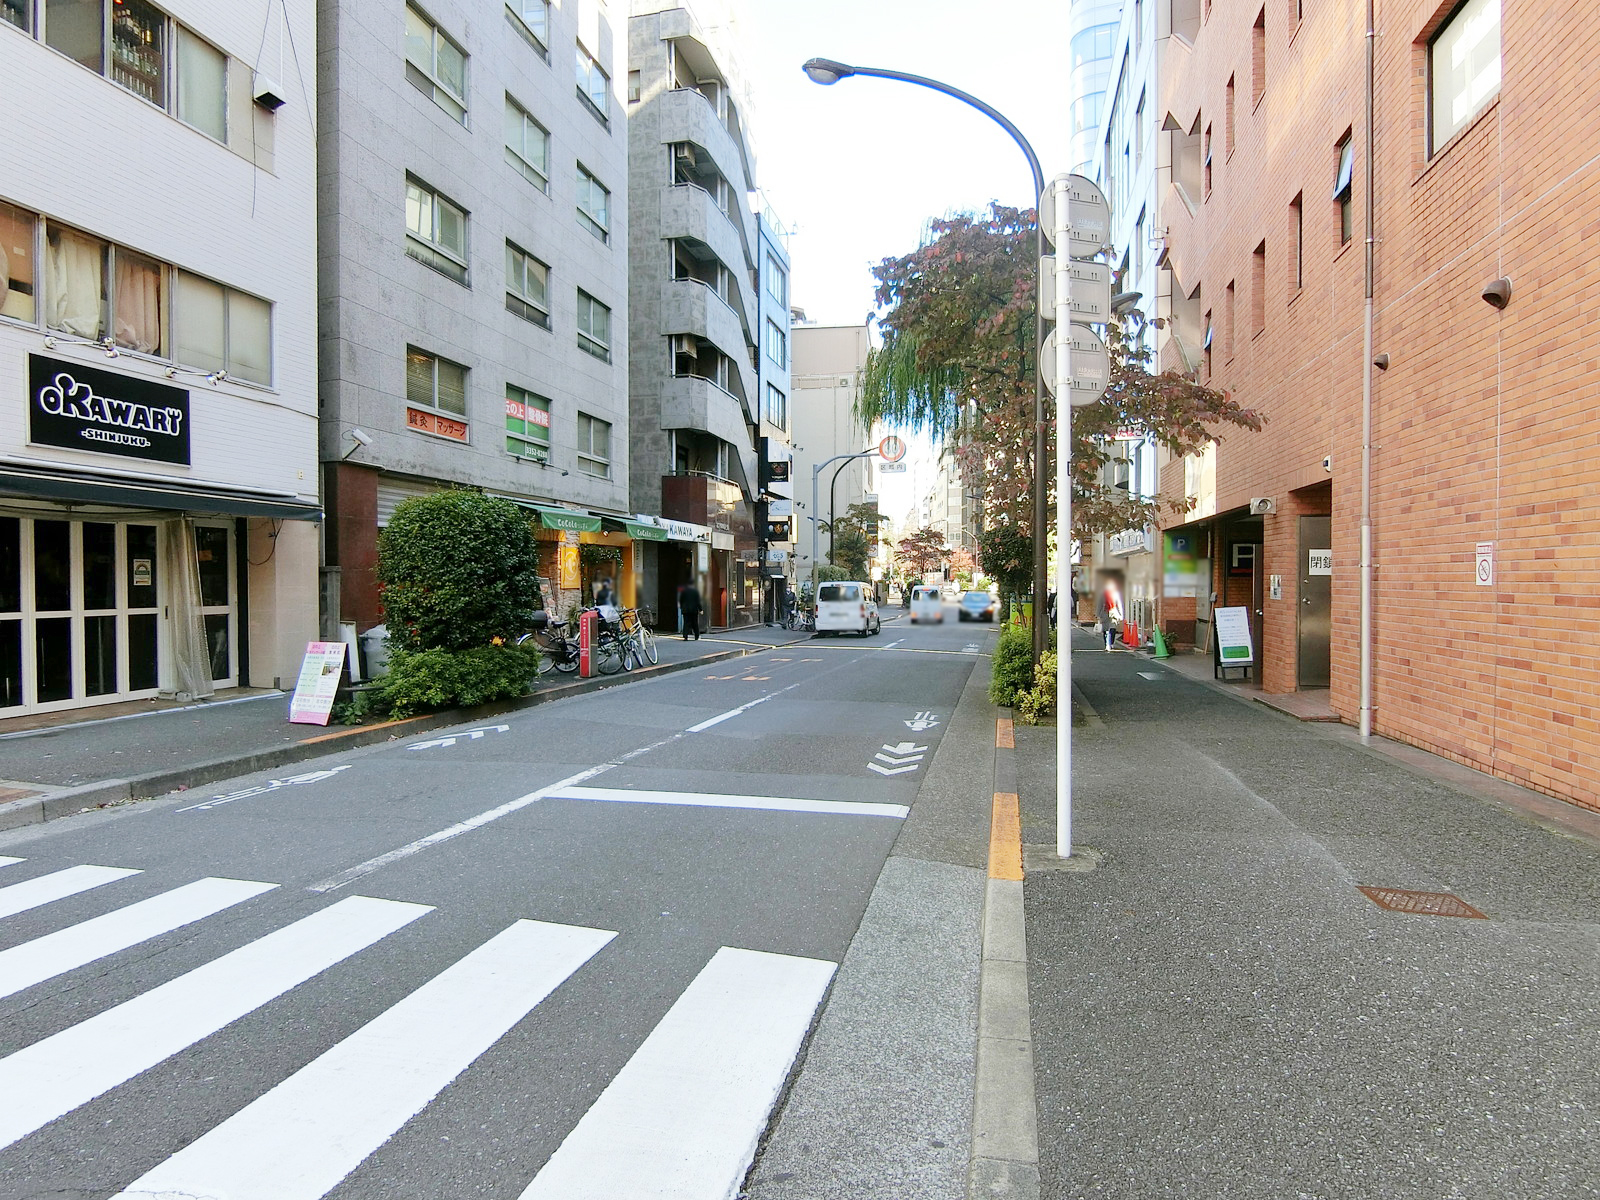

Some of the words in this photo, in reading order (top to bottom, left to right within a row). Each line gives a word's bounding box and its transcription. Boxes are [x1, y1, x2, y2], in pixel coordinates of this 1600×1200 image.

[437, 420, 466, 437] マッサージ
[1177, 539, 1186, 550] P
